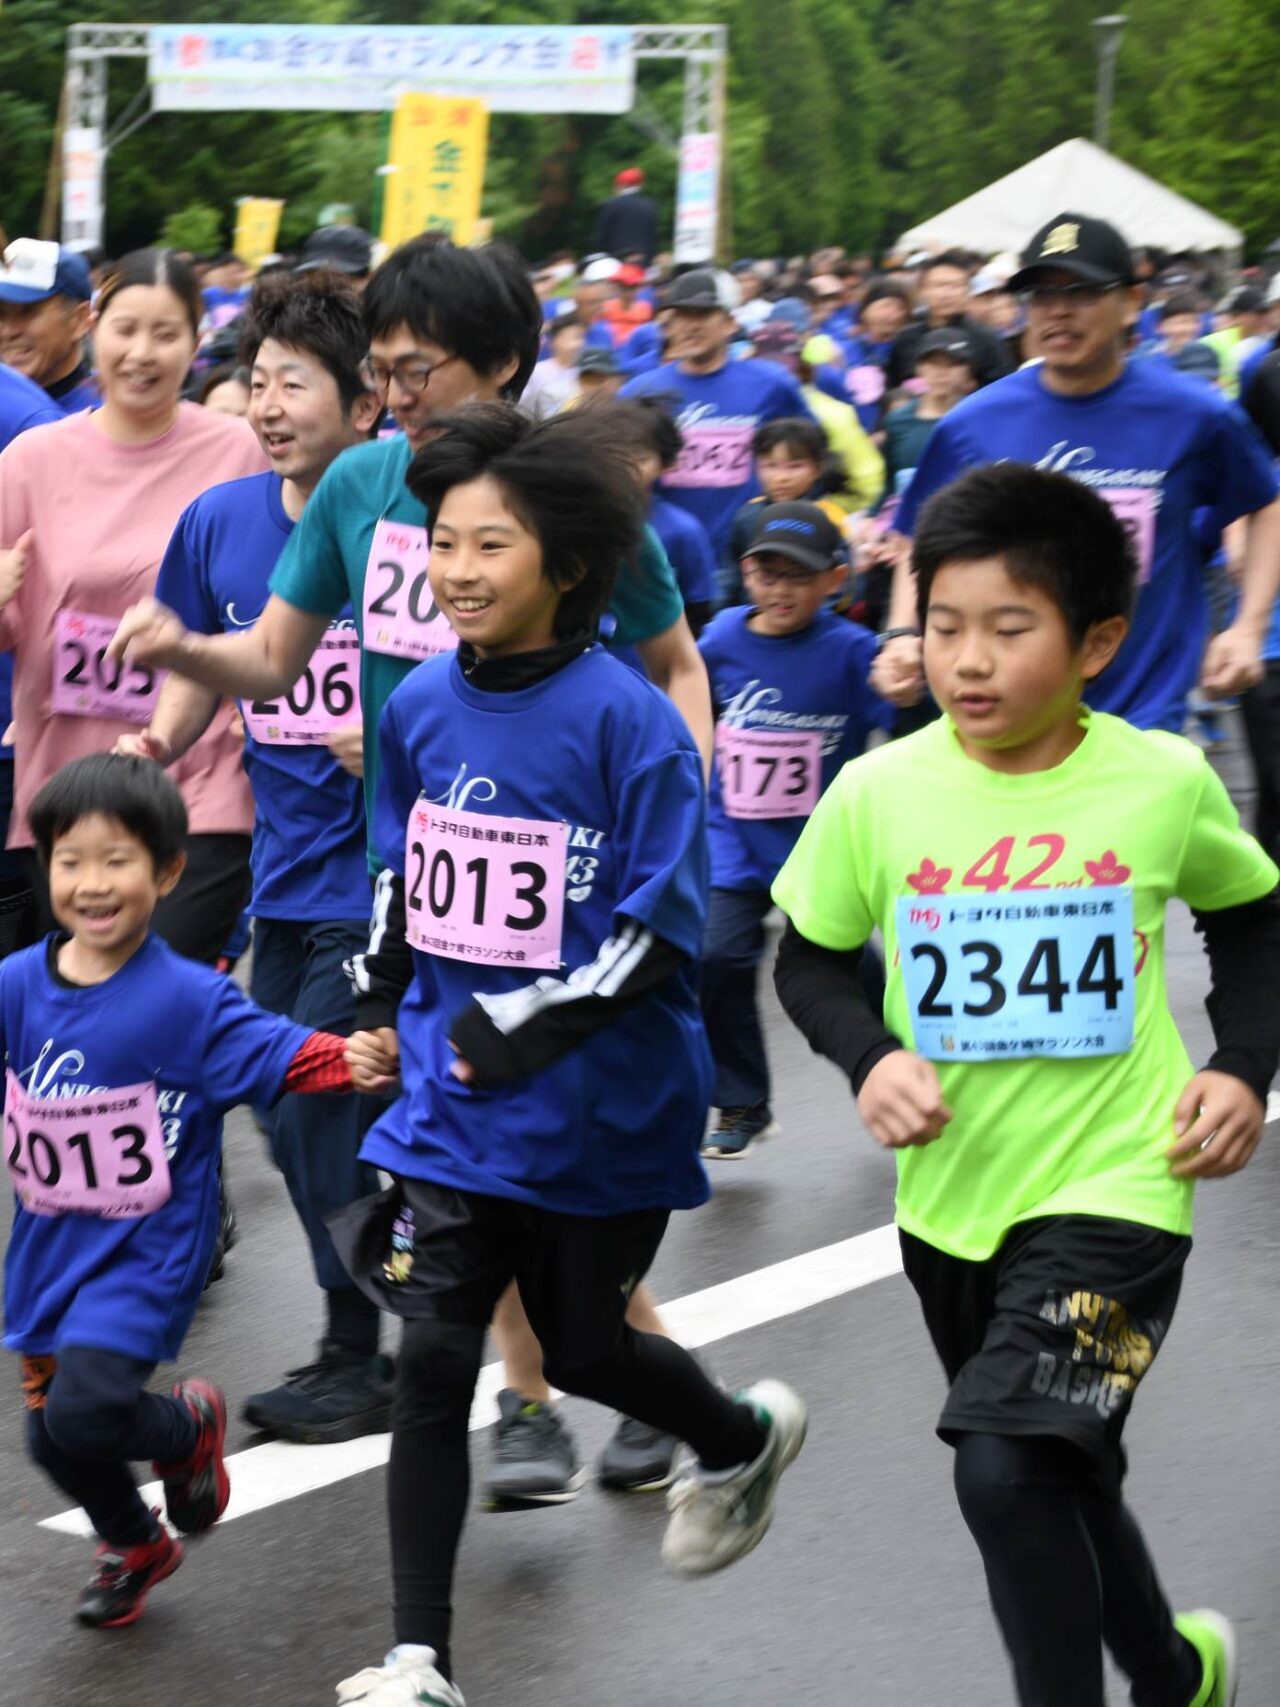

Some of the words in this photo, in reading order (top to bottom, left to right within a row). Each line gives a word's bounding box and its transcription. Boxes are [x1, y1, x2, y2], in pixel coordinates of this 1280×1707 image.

[717, 750, 810, 797] 173
[431, 818, 549, 847] トヨタ自動車東日本
[408, 841, 548, 932] 2013
[949, 900, 1117, 924] トヨタ自動車東日本
[910, 933, 1124, 1017] 2344
[7, 1113, 154, 1190] 2013
